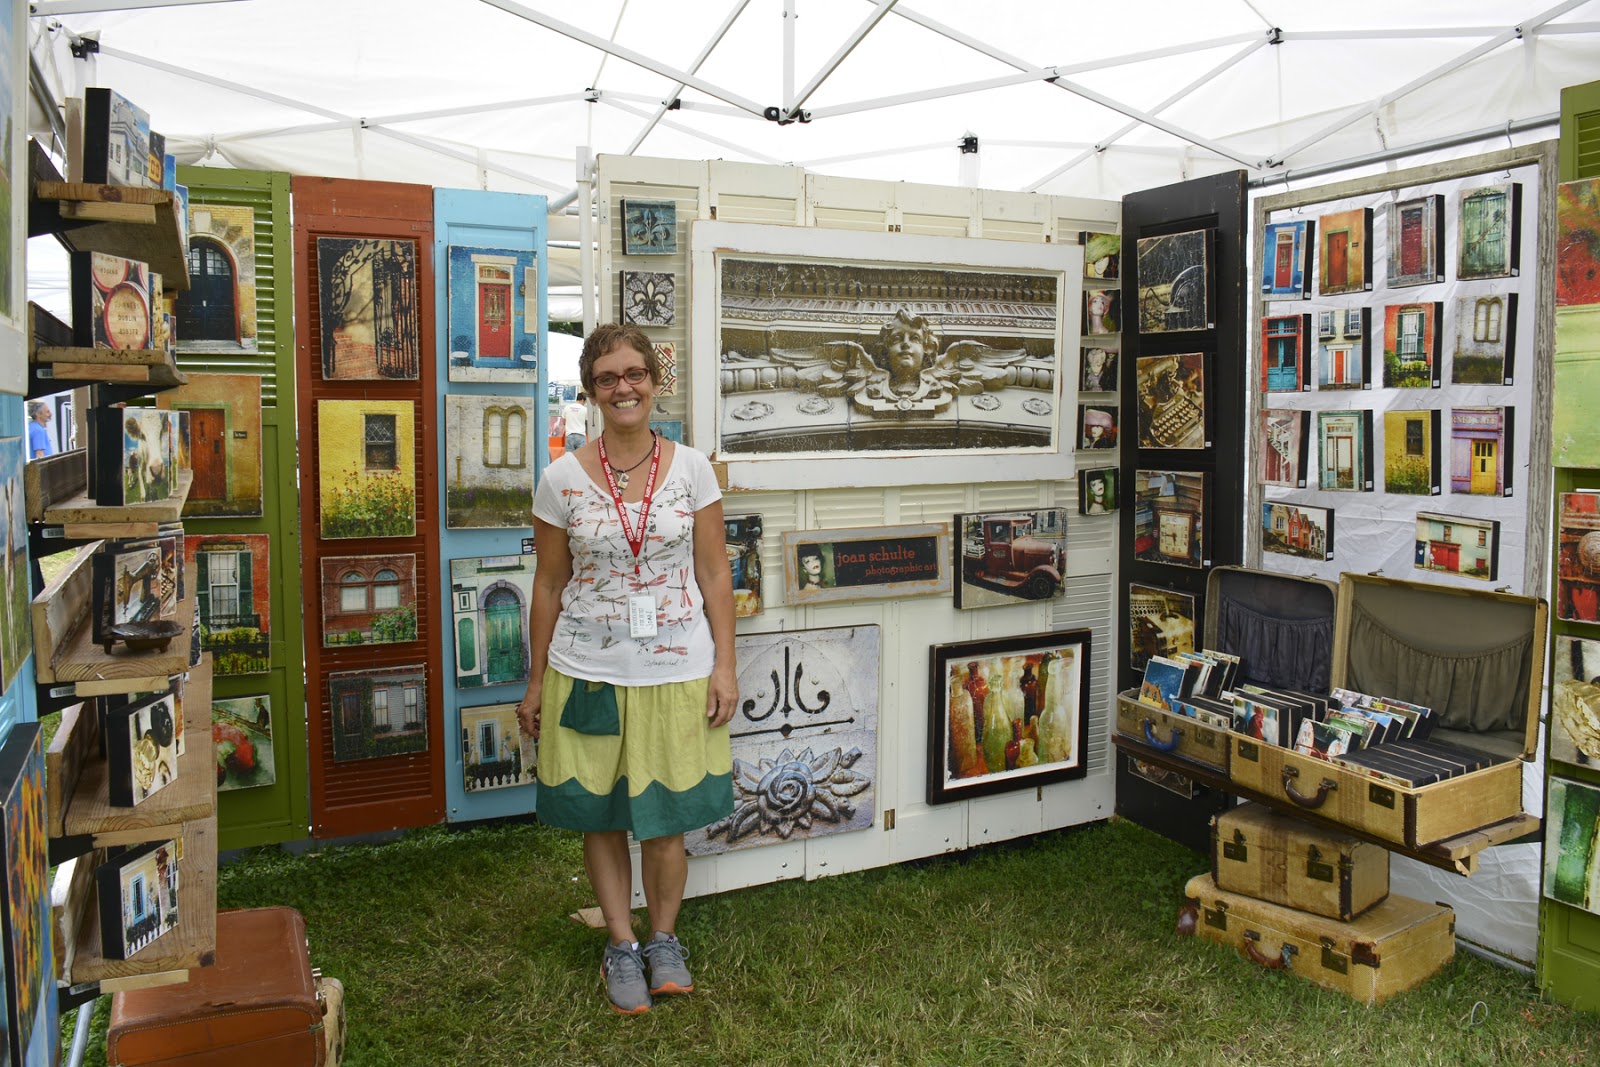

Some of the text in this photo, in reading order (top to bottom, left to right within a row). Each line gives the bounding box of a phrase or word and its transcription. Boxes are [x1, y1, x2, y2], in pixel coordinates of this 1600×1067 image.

[837, 545, 916, 568] joan schulte
[865, 562, 936, 576] photographic art
